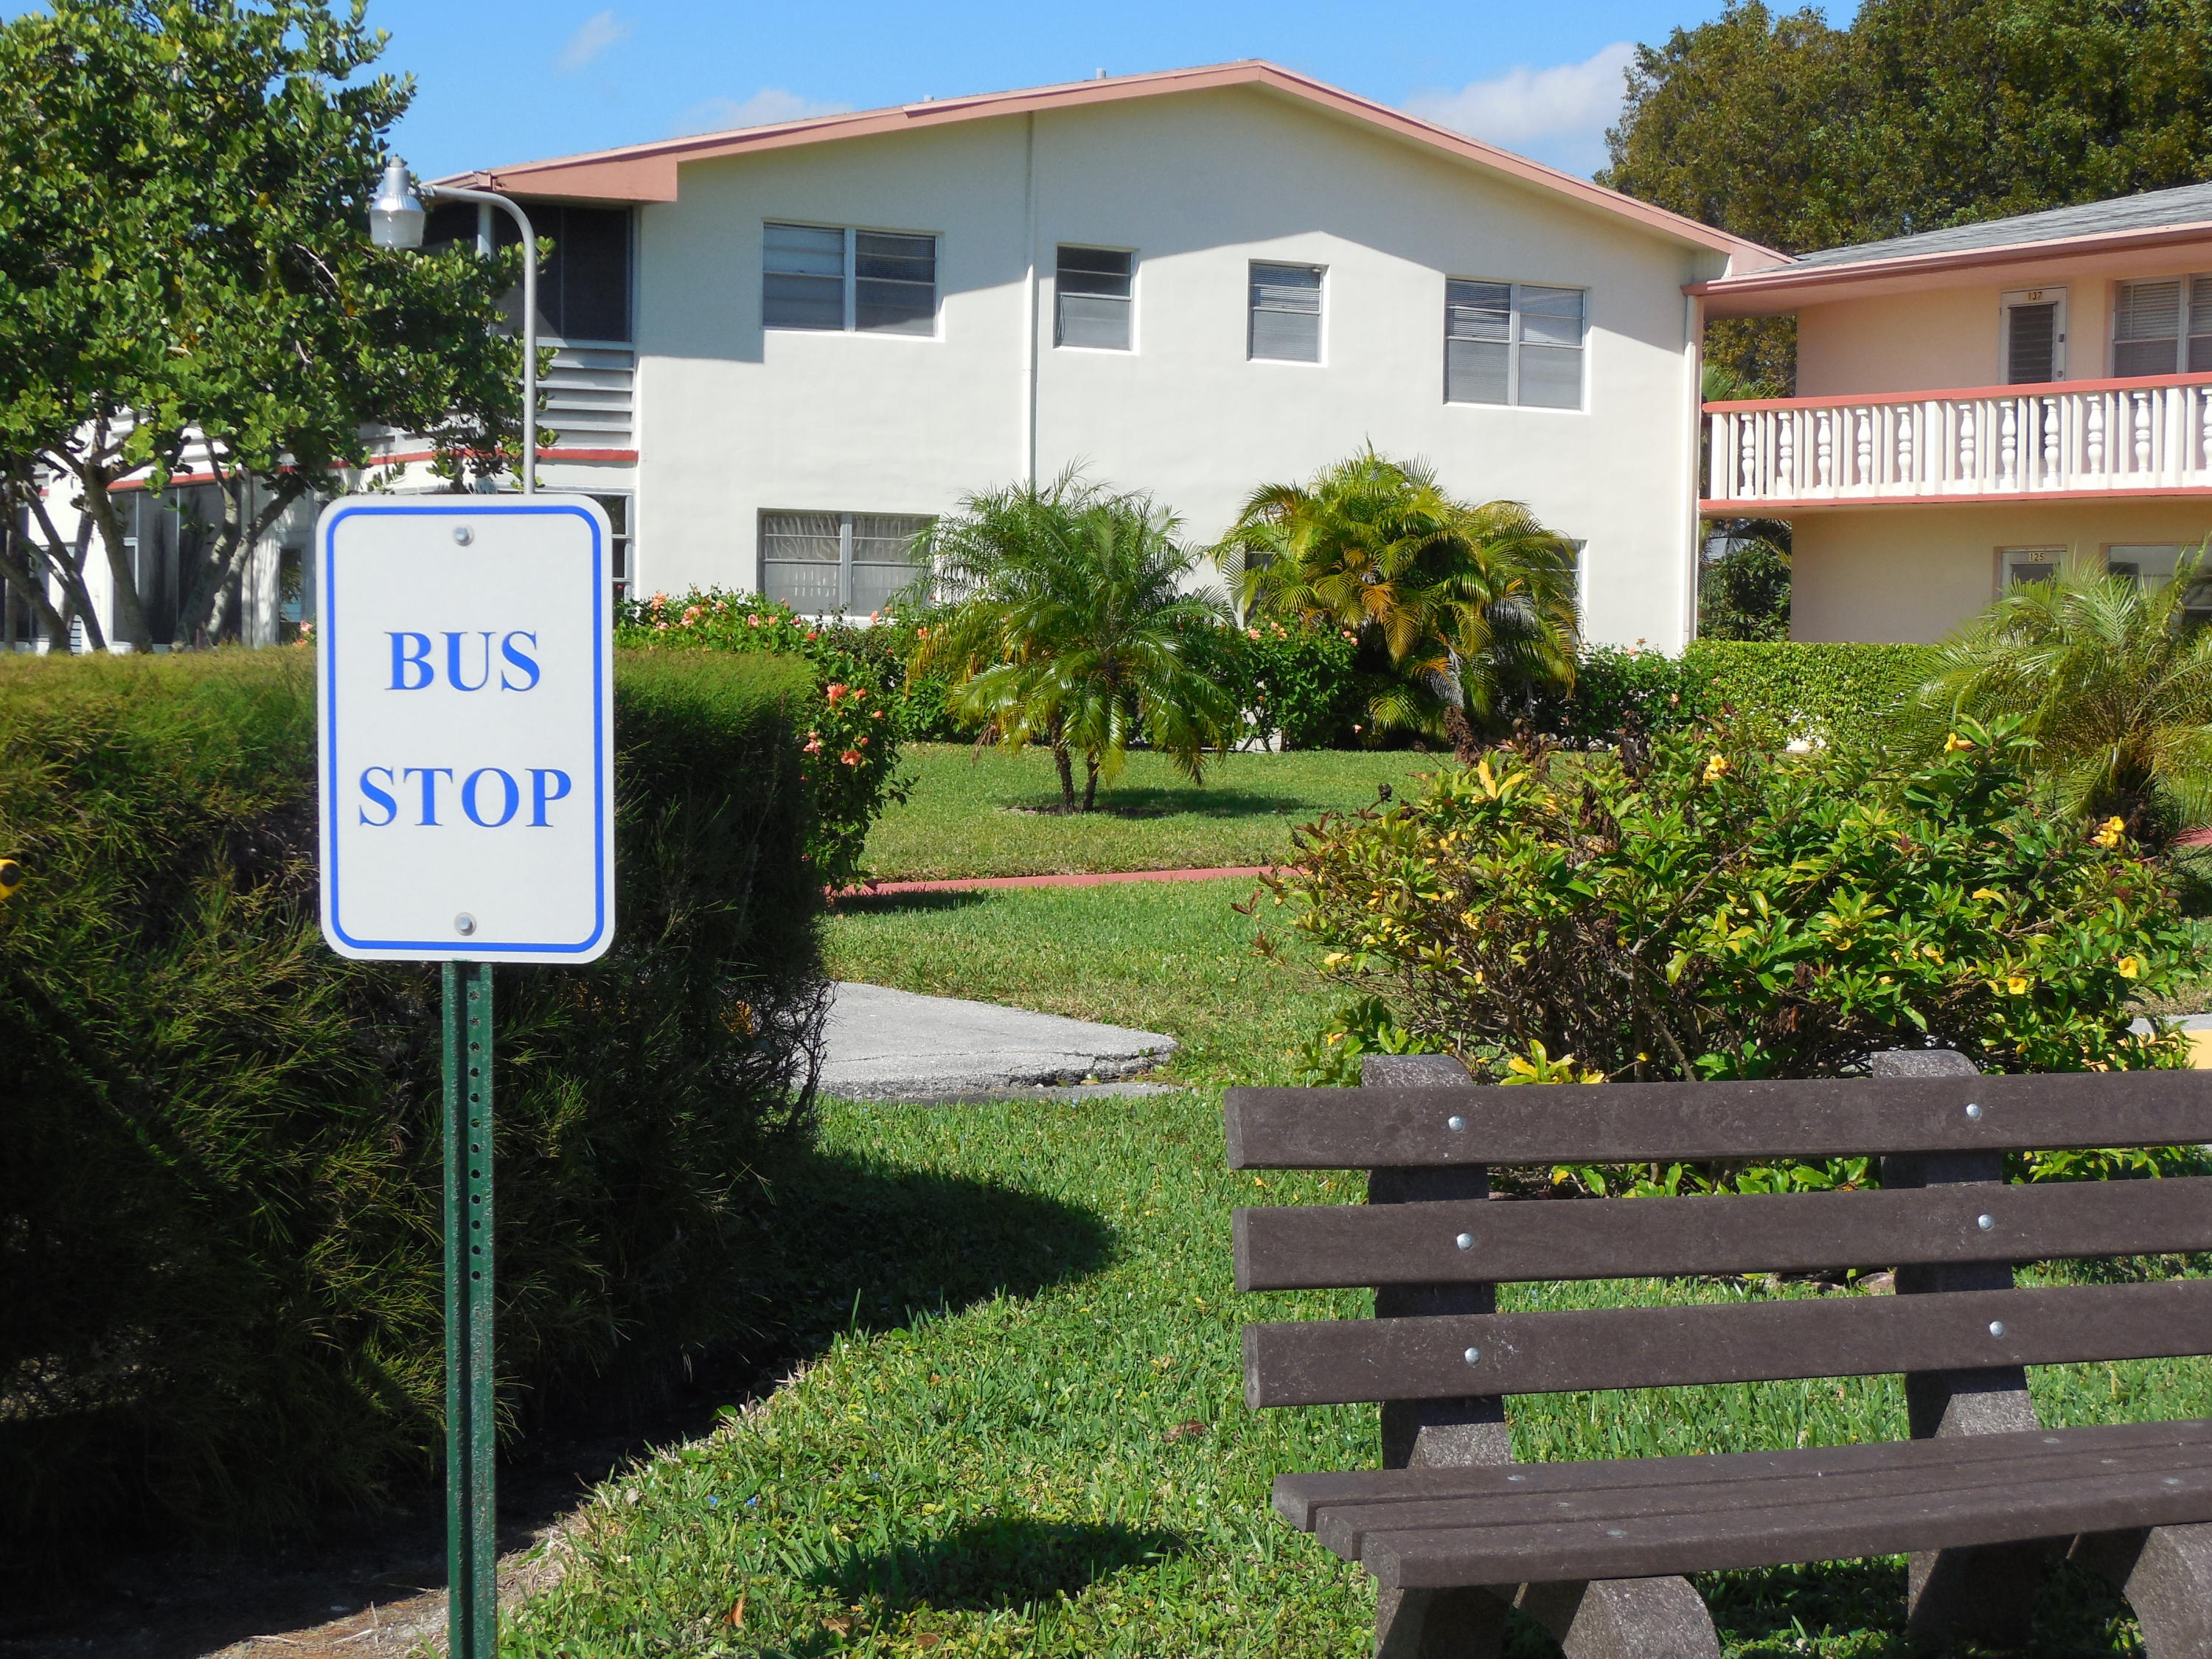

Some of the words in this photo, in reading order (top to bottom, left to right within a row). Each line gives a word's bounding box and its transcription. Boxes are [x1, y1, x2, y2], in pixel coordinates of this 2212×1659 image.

[2028, 291, 2042, 301] 137
[2029, 553, 2045, 561] 125
[384, 631, 540, 692] BUS
[359, 766, 572, 827] STOP
